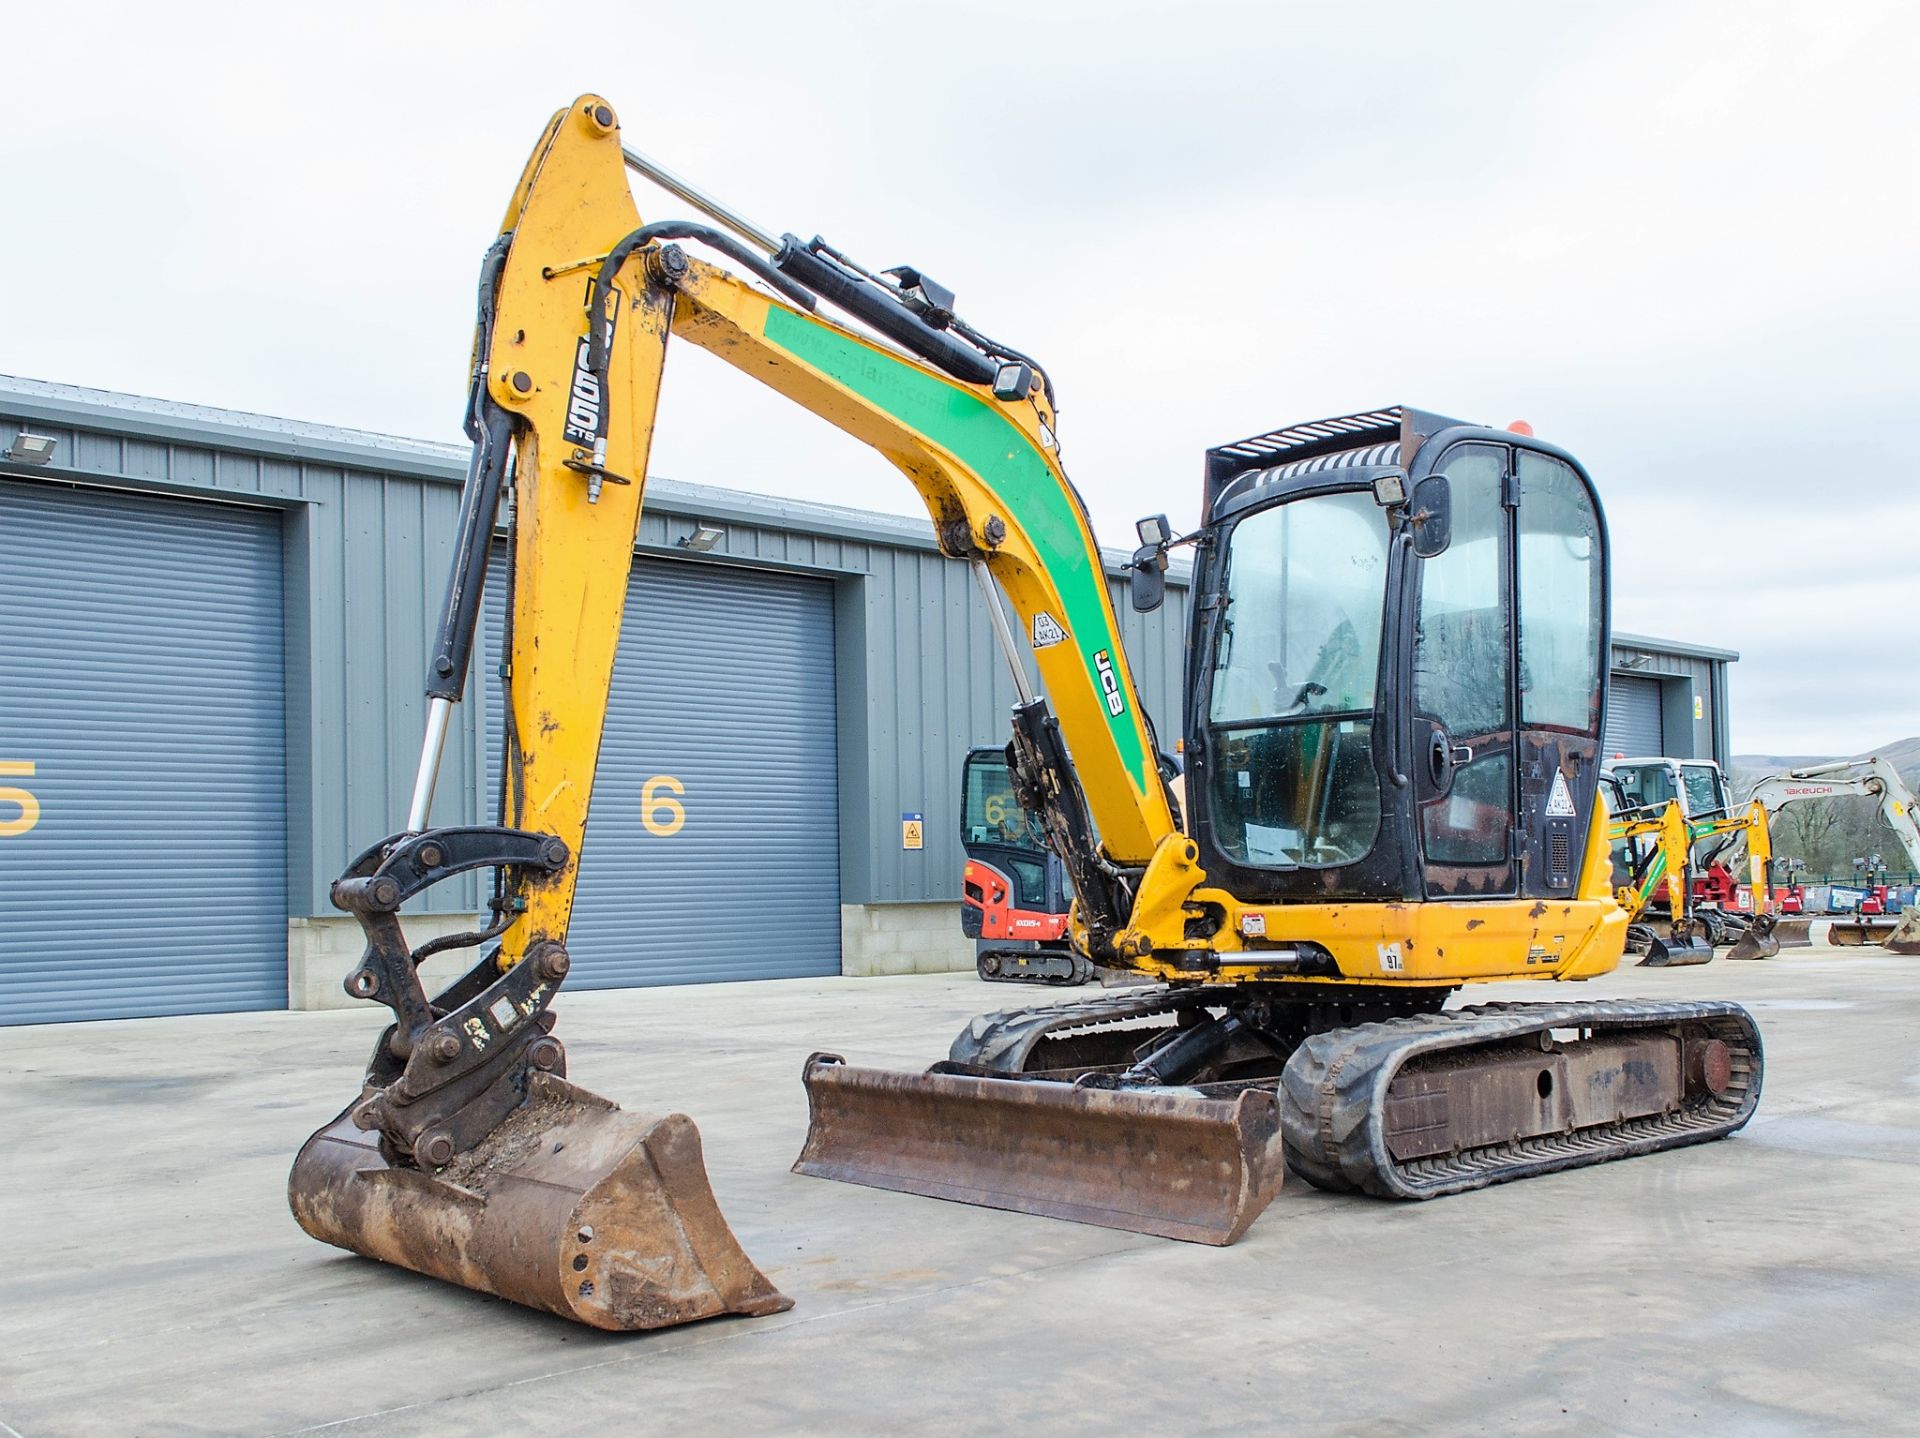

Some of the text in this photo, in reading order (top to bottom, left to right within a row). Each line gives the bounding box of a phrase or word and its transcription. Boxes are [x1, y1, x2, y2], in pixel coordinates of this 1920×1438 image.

[566, 424, 596, 442] ZTS
[1093, 650, 1124, 717] JCB
[641, 775, 686, 837] 6
[1386, 955, 1397, 969] 97
